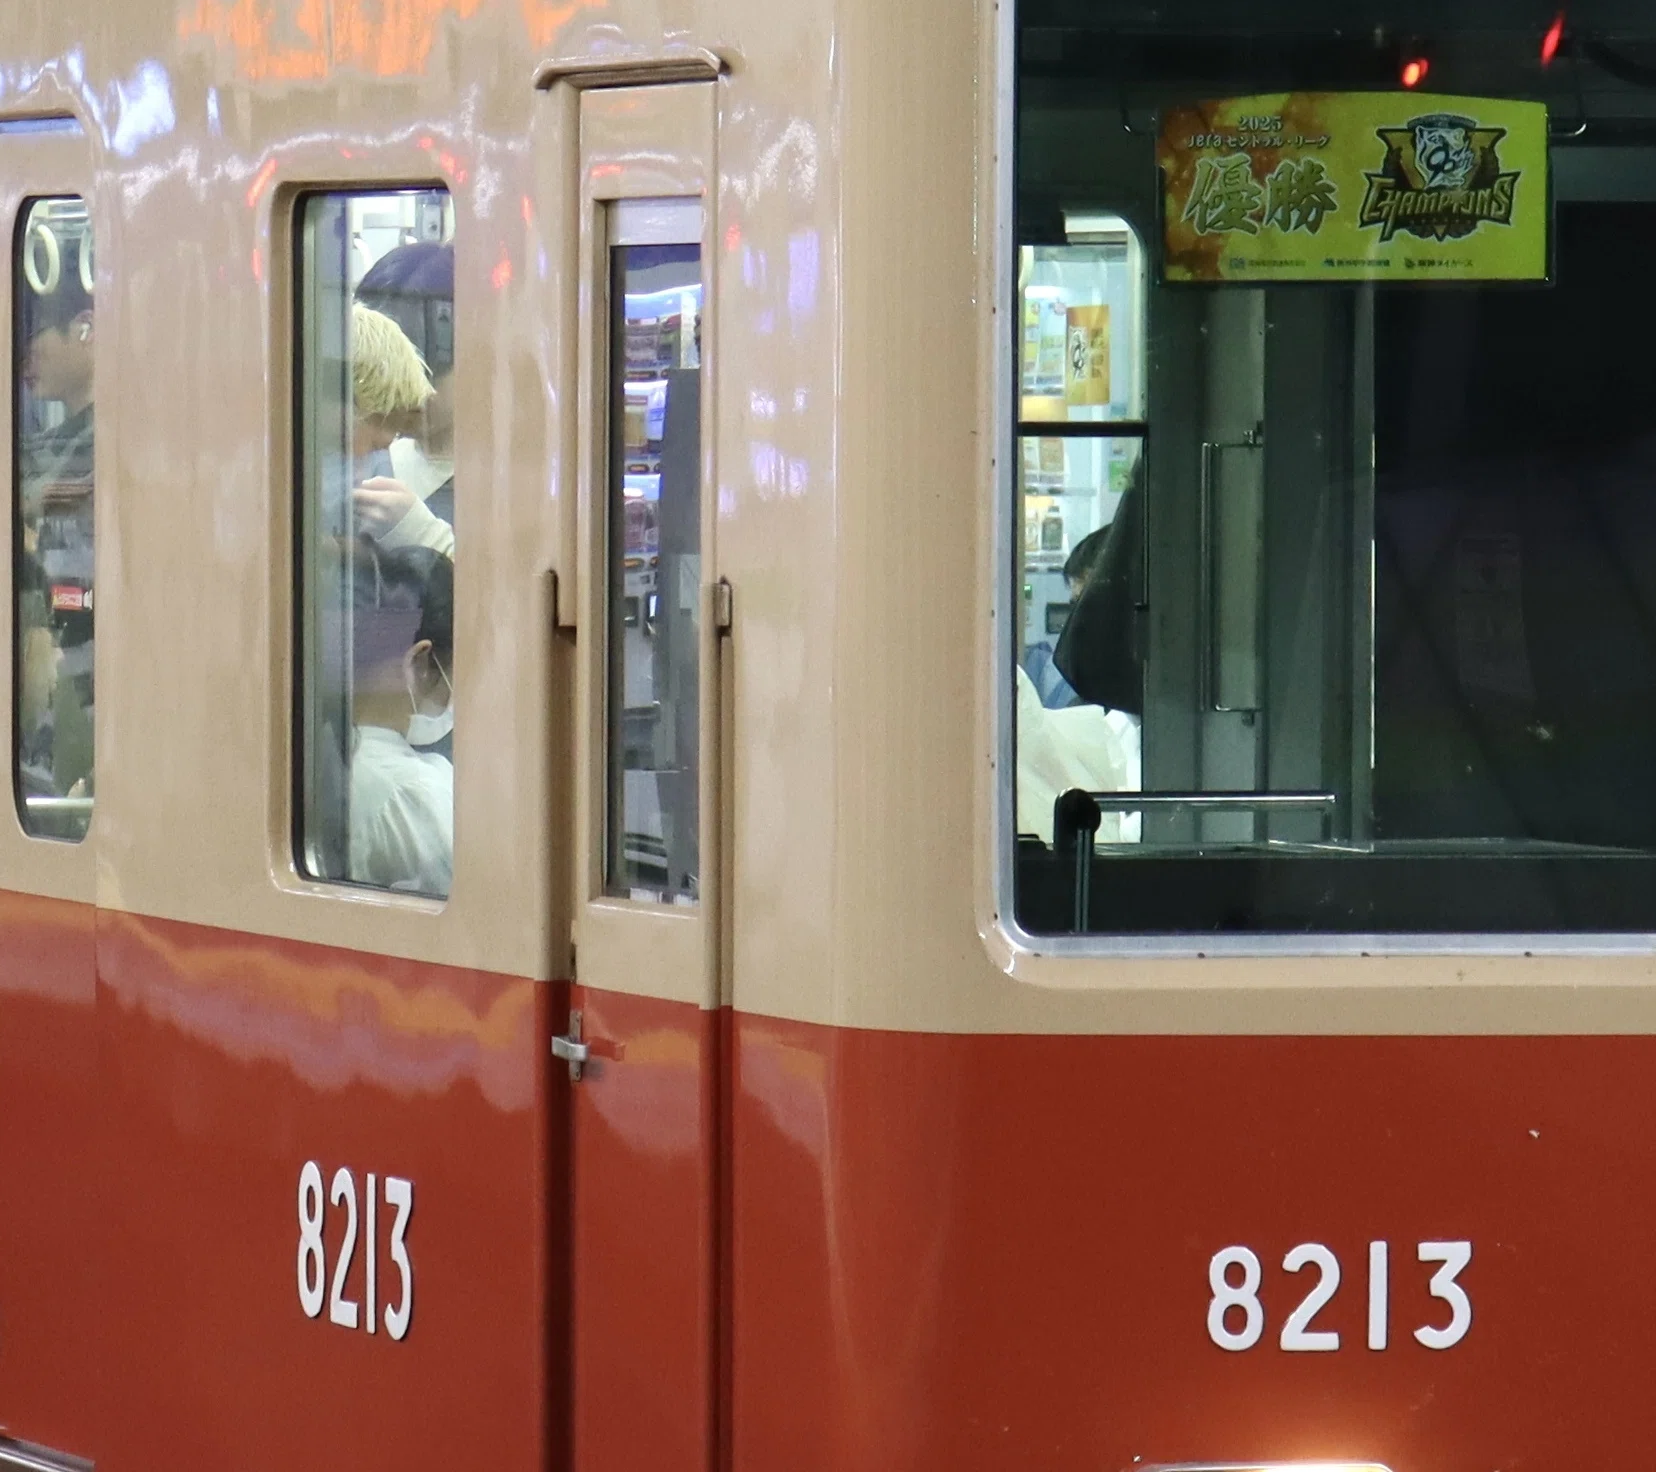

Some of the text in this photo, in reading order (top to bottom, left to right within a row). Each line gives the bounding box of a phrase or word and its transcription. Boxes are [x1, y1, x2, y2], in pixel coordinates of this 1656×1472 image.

[1238, 115, 1284, 131] 2025
[1181, 152, 1339, 236] 優勝
[296, 1159, 414, 1341] 8213
[1206, 1239, 1473, 1352] 8213
